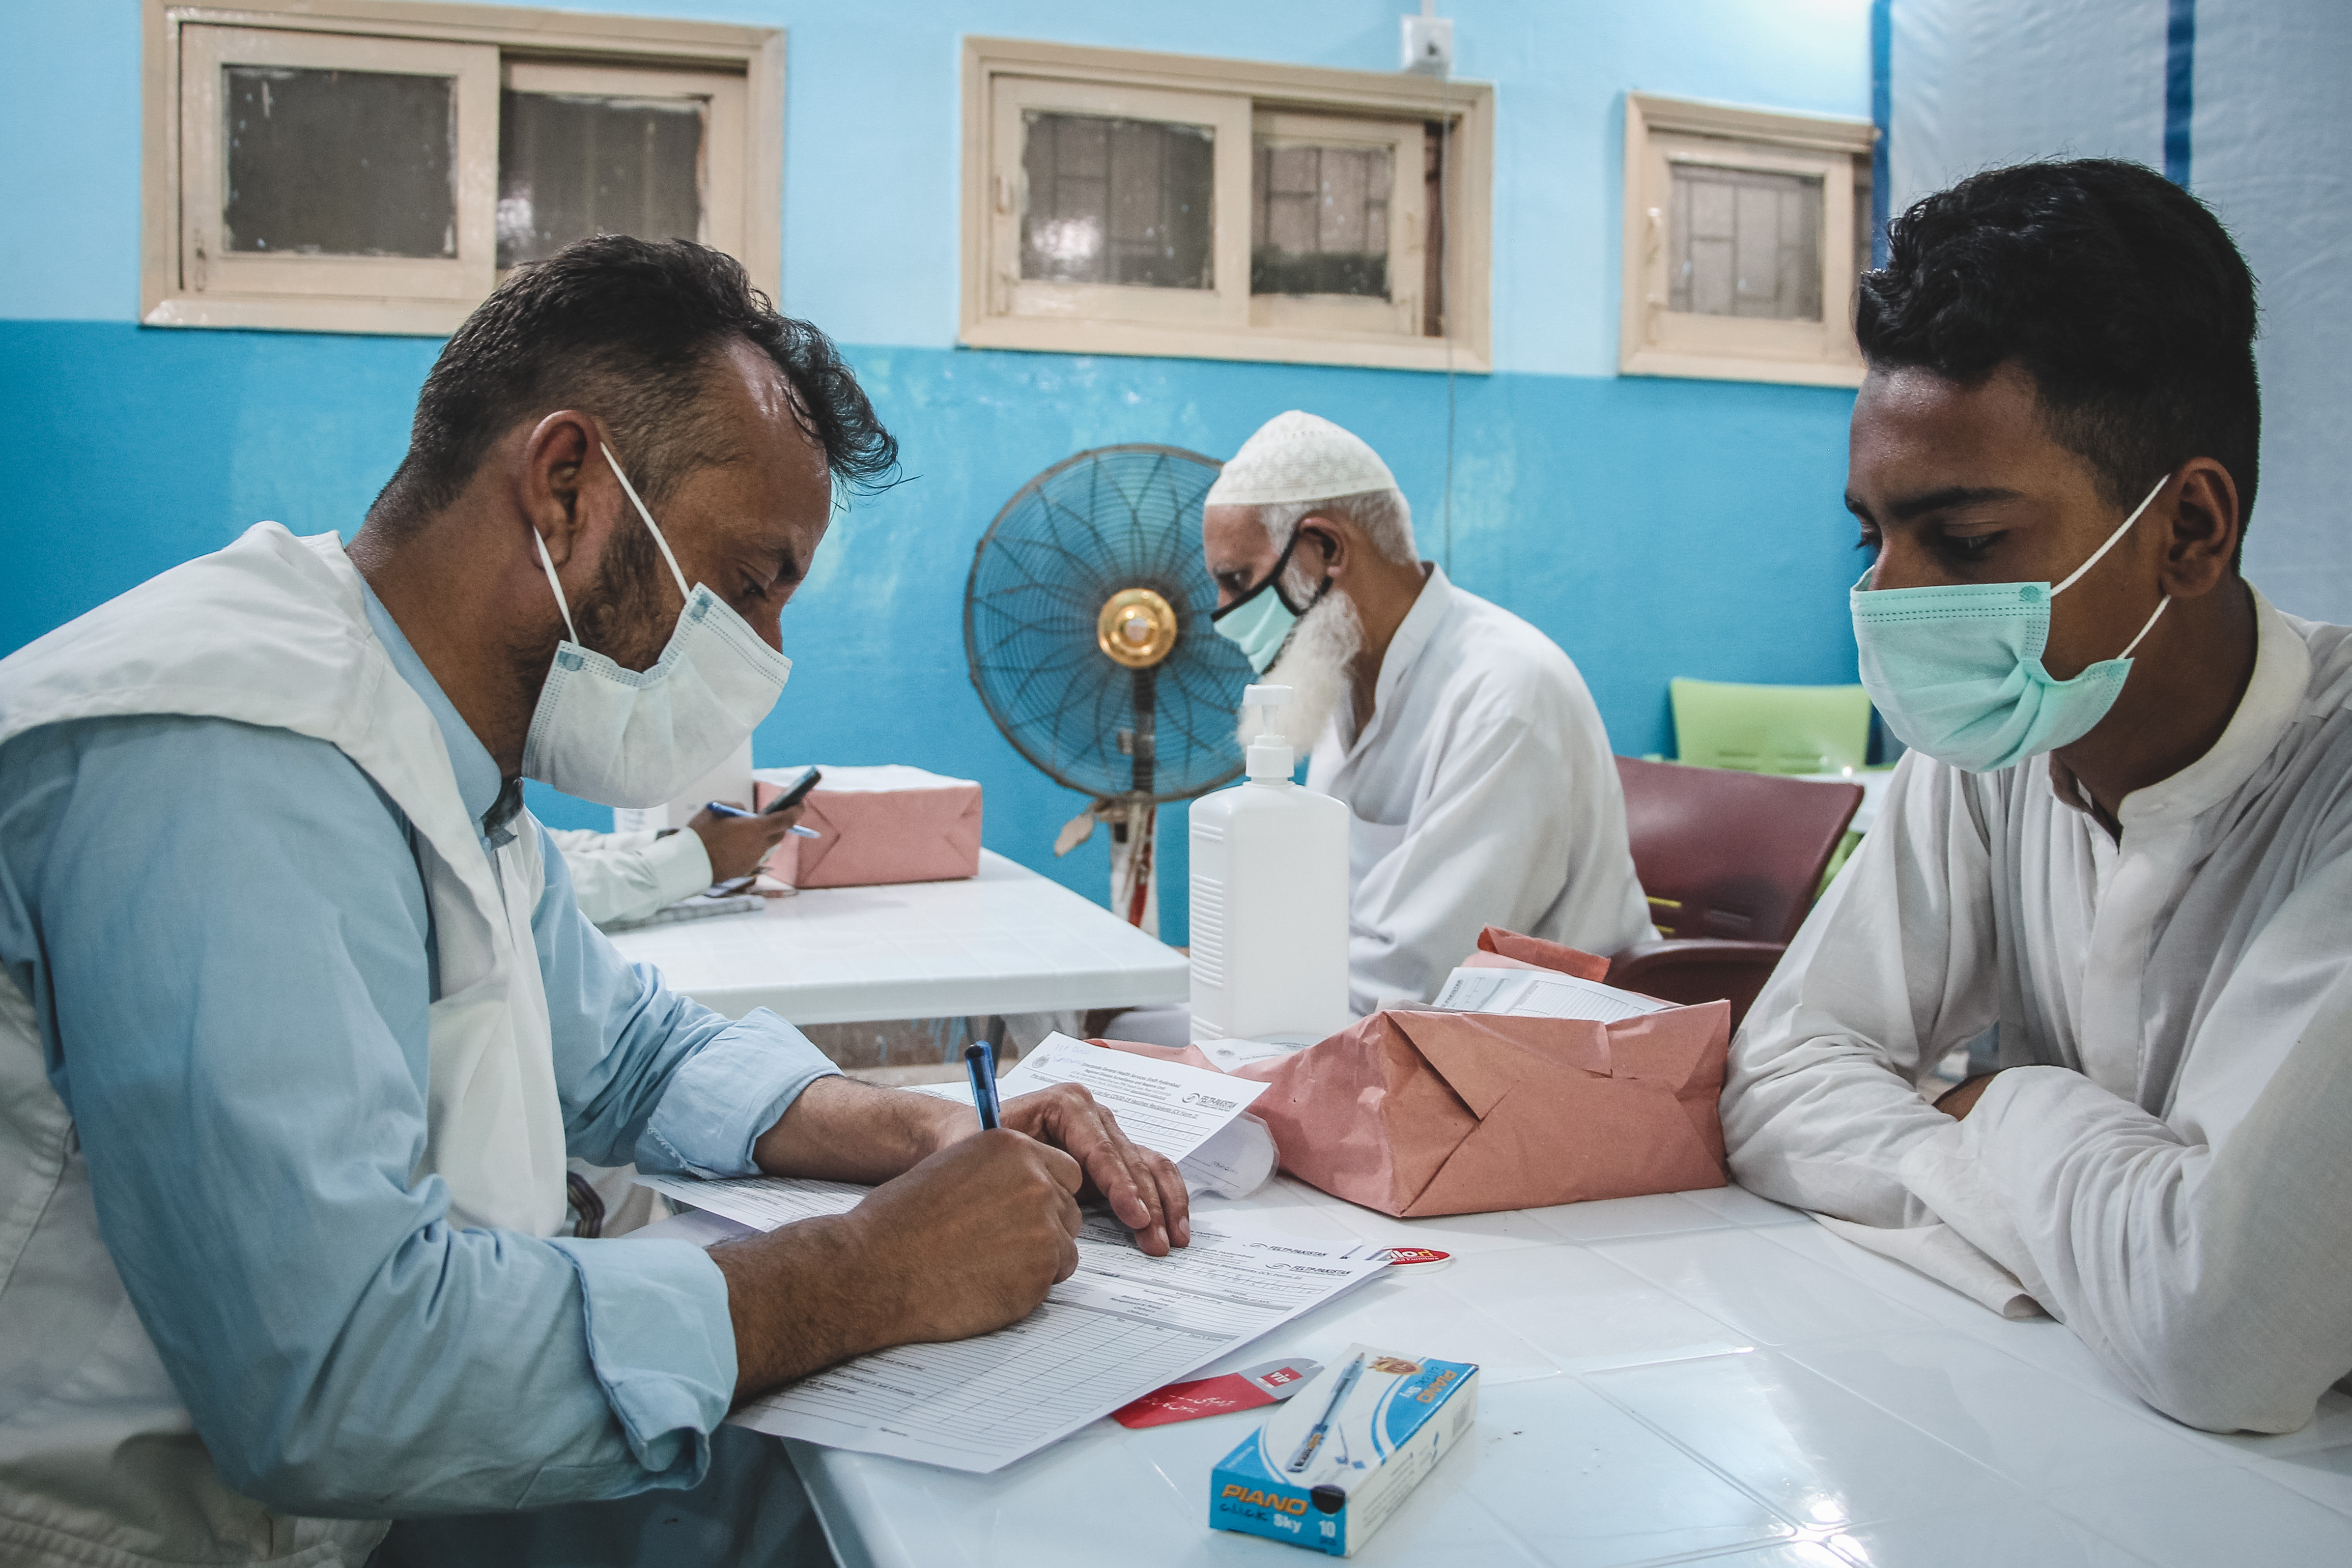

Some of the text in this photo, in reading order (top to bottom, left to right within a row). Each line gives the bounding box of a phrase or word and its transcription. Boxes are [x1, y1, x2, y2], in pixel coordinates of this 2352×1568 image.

[1158, 1080, 1180, 1088] Hyderabad
[1110, 1094, 1131, 1102] COVID-19
[1148, 1103, 1172, 1113] Recipients
[1269, 1246, 1328, 1256] FELTP-PAKISTAN
[1220, 1264, 1257, 1273] Recipients
[1291, 1265, 1353, 1275] FELTP-PAKISTAN
[1143, 1289, 1181, 1299] Temperature
[1110, 1297, 1145, 1306] Respiratory
[1415, 1370, 1457, 1404] PIANO
[1221, 1484, 1308, 1516] PIANO
[1273, 1513, 1302, 1534] Sky
[1318, 1520, 1337, 1538] 10
